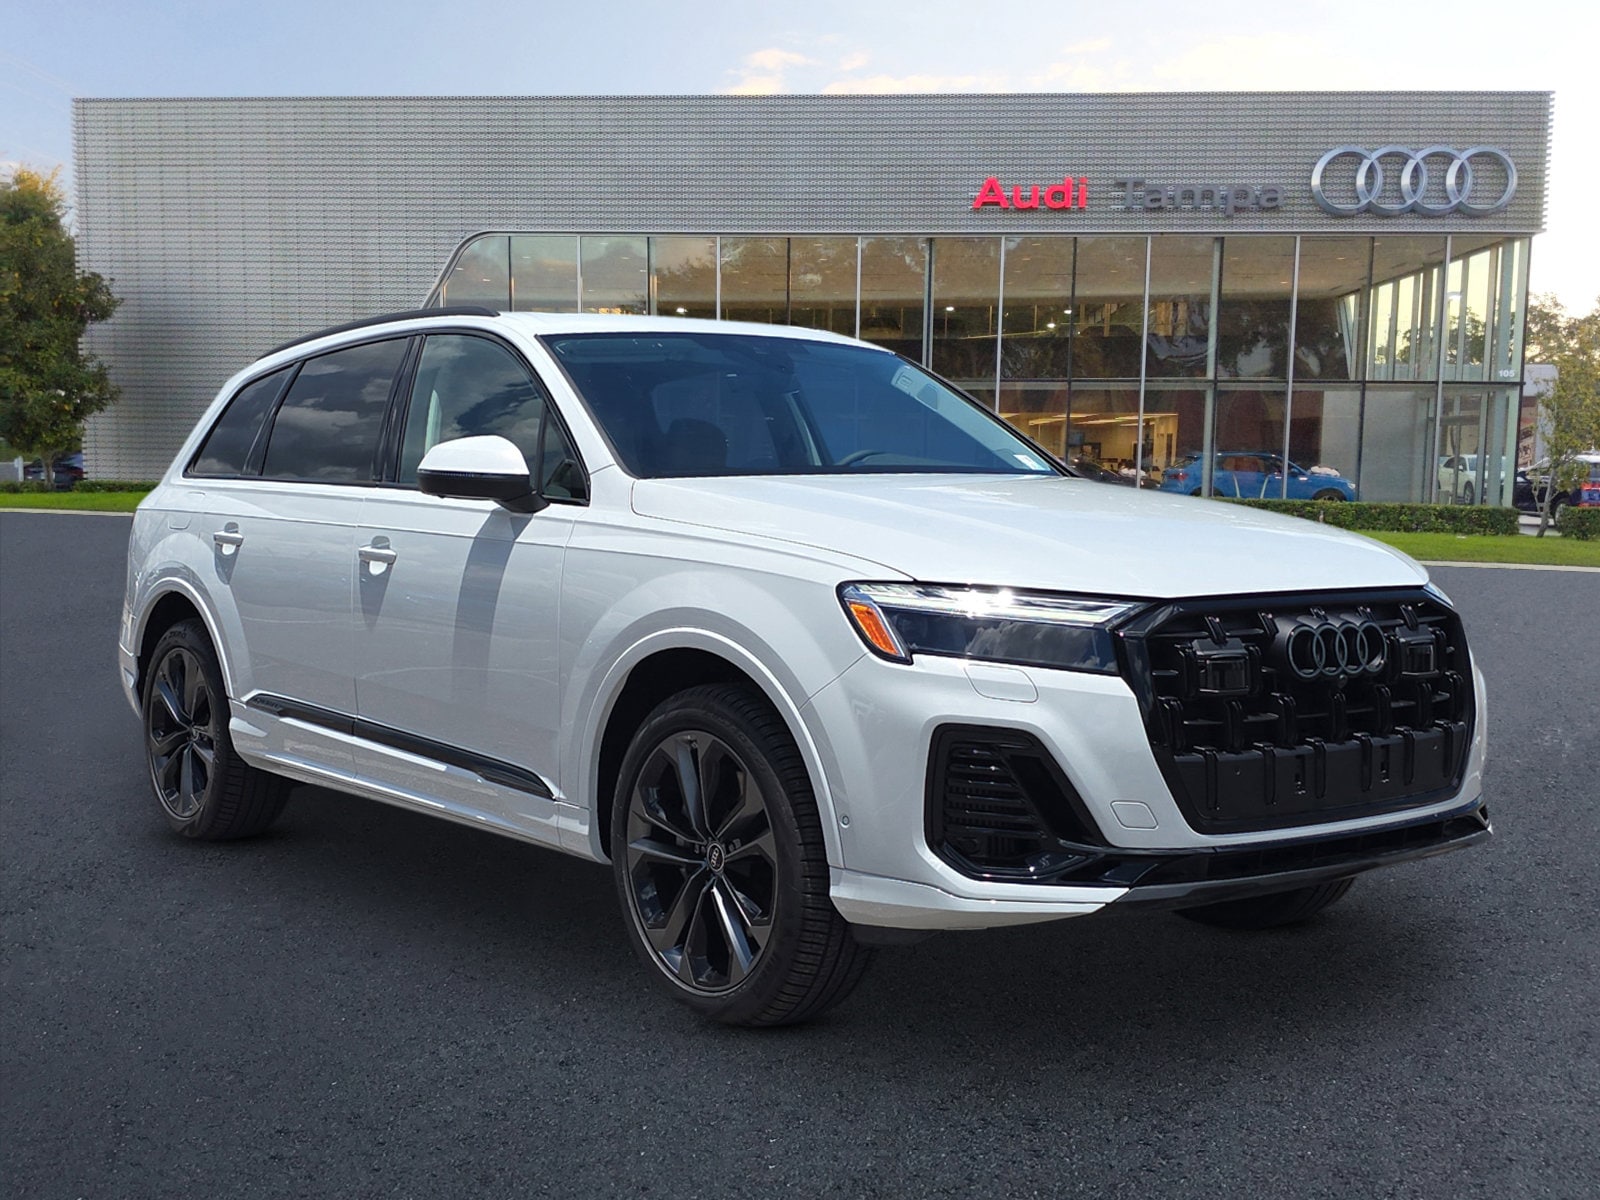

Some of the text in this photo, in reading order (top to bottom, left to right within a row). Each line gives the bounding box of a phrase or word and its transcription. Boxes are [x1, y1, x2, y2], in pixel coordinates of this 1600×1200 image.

[972, 176, 1284, 217] Audi Tampa
[1499, 369, 1515, 378] 105
